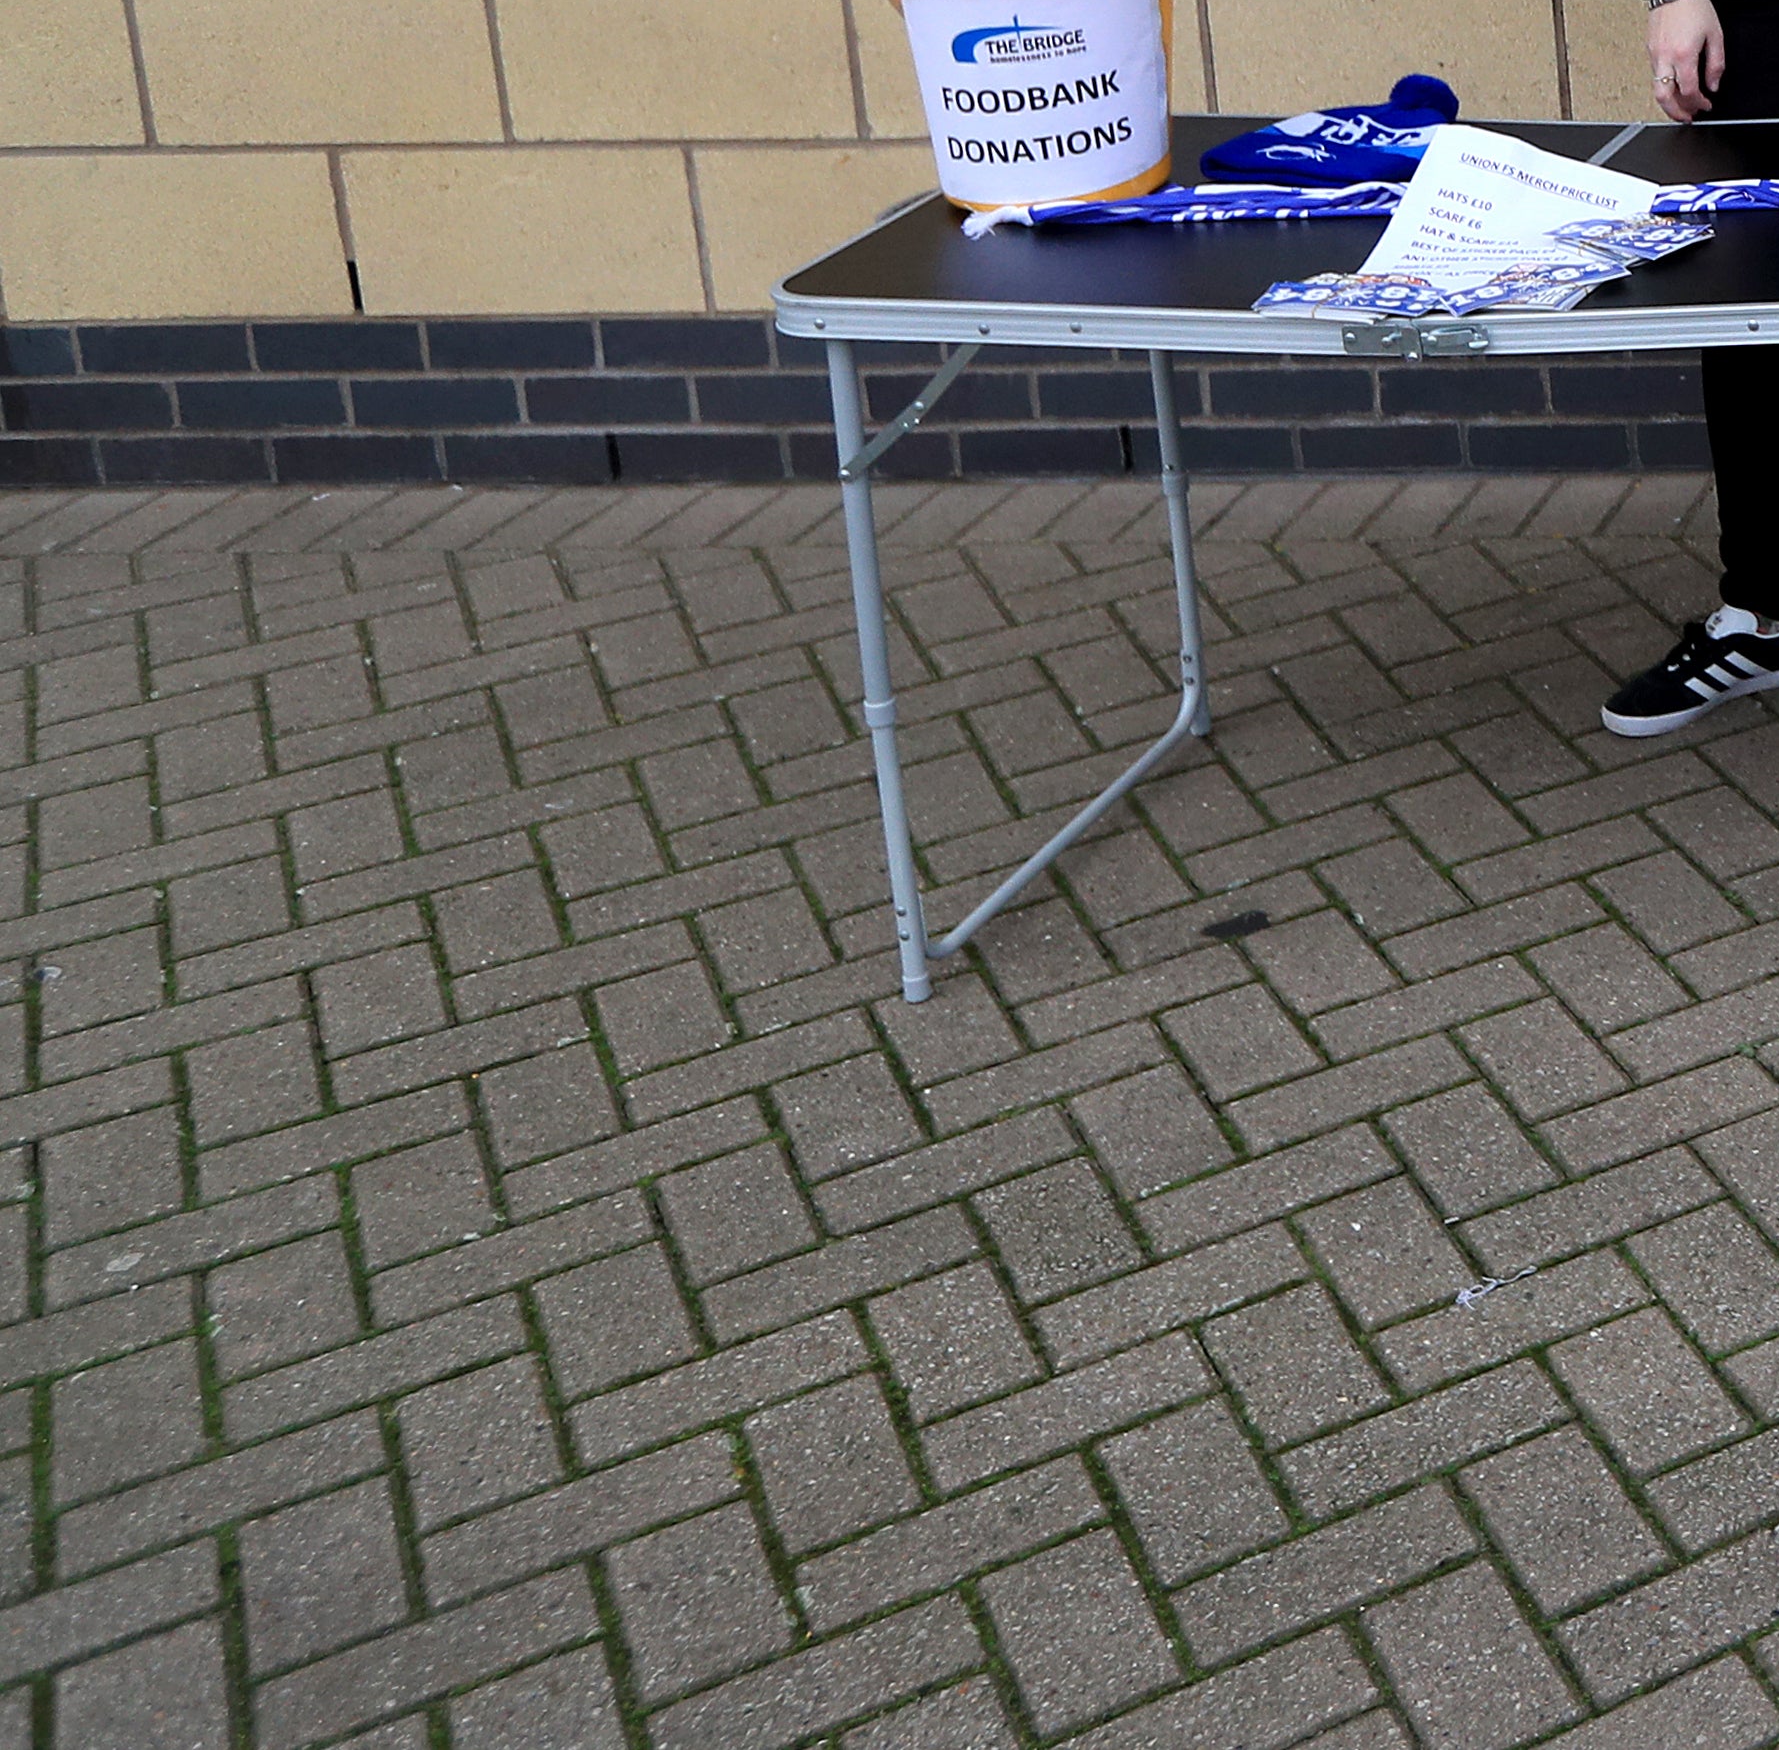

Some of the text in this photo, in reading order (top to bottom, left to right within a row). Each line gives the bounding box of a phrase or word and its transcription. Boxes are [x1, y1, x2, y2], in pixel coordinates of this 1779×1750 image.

[984, 28, 1086, 55] THE BRIDGE
[941, 69, 1121, 114] FOODBANK
[948, 116, 1133, 165] DONATIONS
[1460, 152, 1500, 171] UNION
[1517, 170, 1559, 193] MERCH
[1560, 185, 1593, 202] PRICE
[1594, 195, 1620, 210] LIST
[1437, 188, 1493, 211] HATS £10
[1428, 206, 1466, 225] SCARF
[1410, 239, 1440, 251] BEST
[1419, 224, 1444, 238] HAT
[1458, 235, 1497, 246] SCARF
